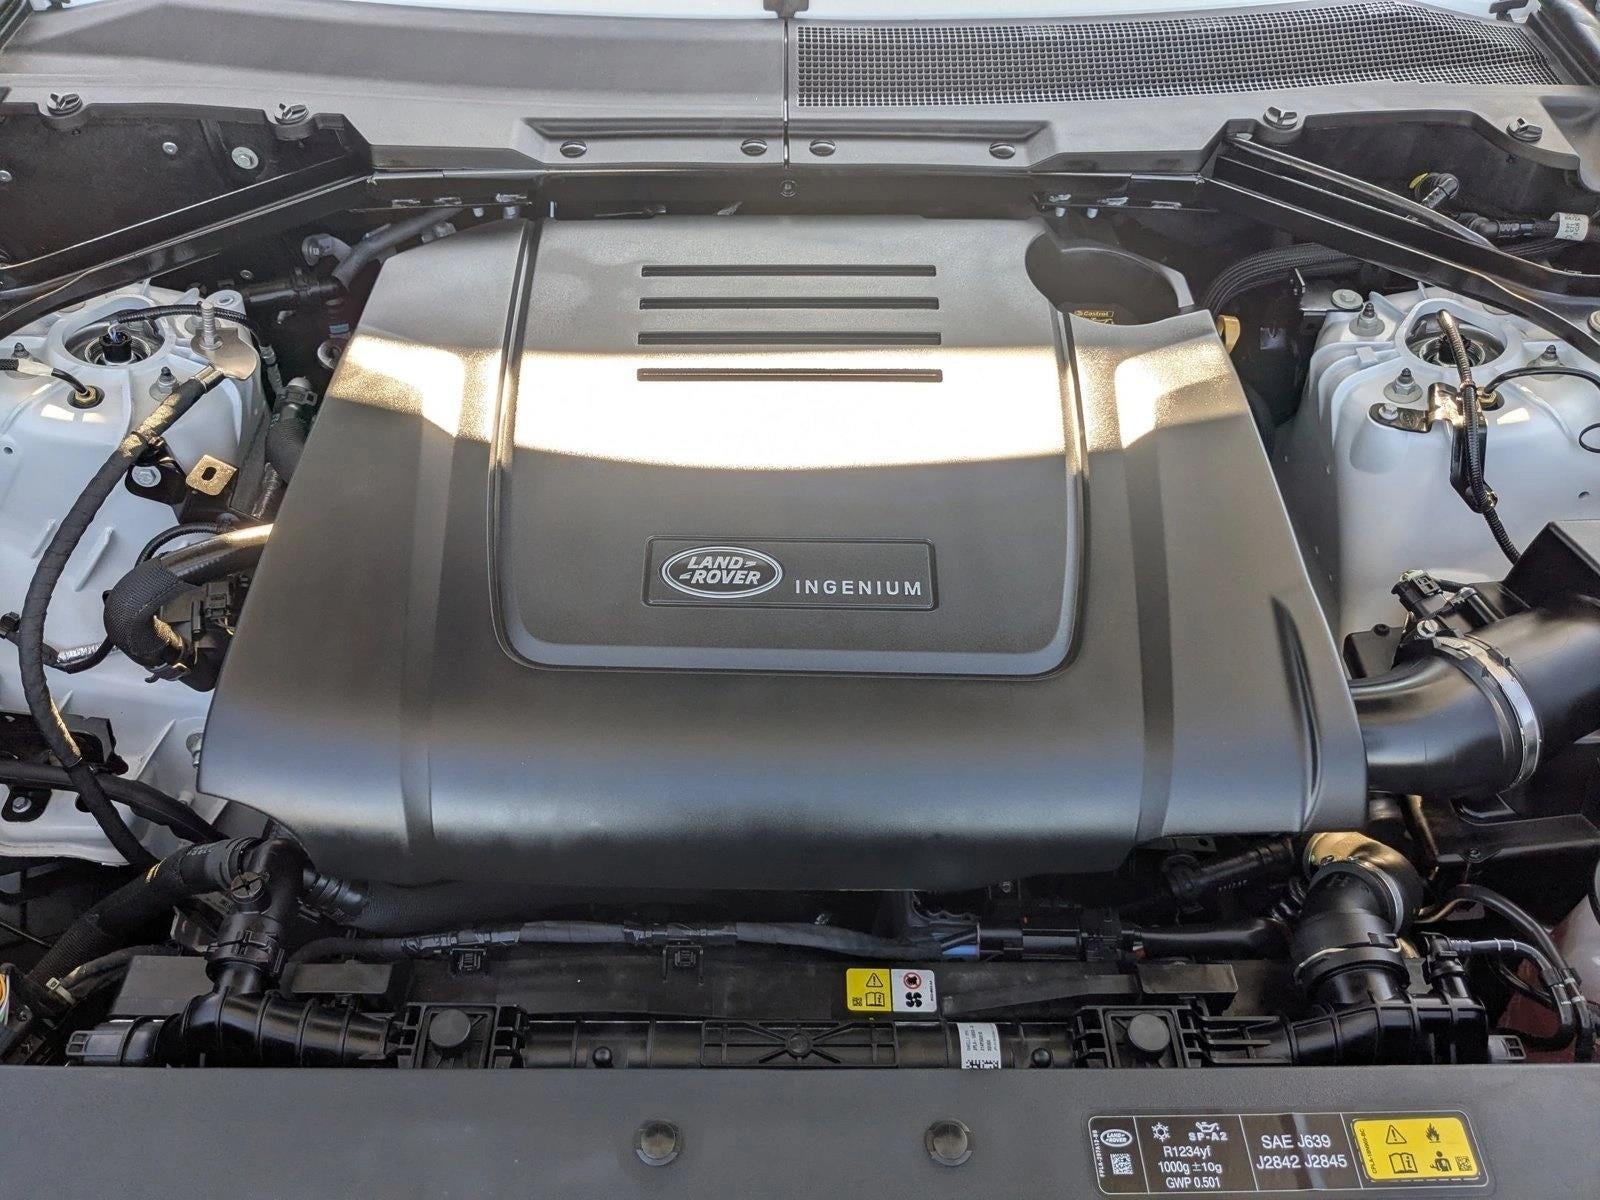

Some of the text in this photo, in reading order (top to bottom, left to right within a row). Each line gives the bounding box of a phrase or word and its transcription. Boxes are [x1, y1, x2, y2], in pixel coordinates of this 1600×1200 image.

[687, 556, 744, 569] LAND
[690, 569, 761, 585] ROVER
[795, 579, 922, 596] INGENIUM
[1188, 1131, 1228, 1141] SP-A2
[1261, 1134, 1331, 1149] SAE J639
[1163, 1145, 1211, 1160] R1234yf
[1158, 1161, 1190, 1175] 1000g
[1256, 1153, 1348, 1169] J2842 J2845
[1165, 1176, 1221, 1189] GWP 0.501
